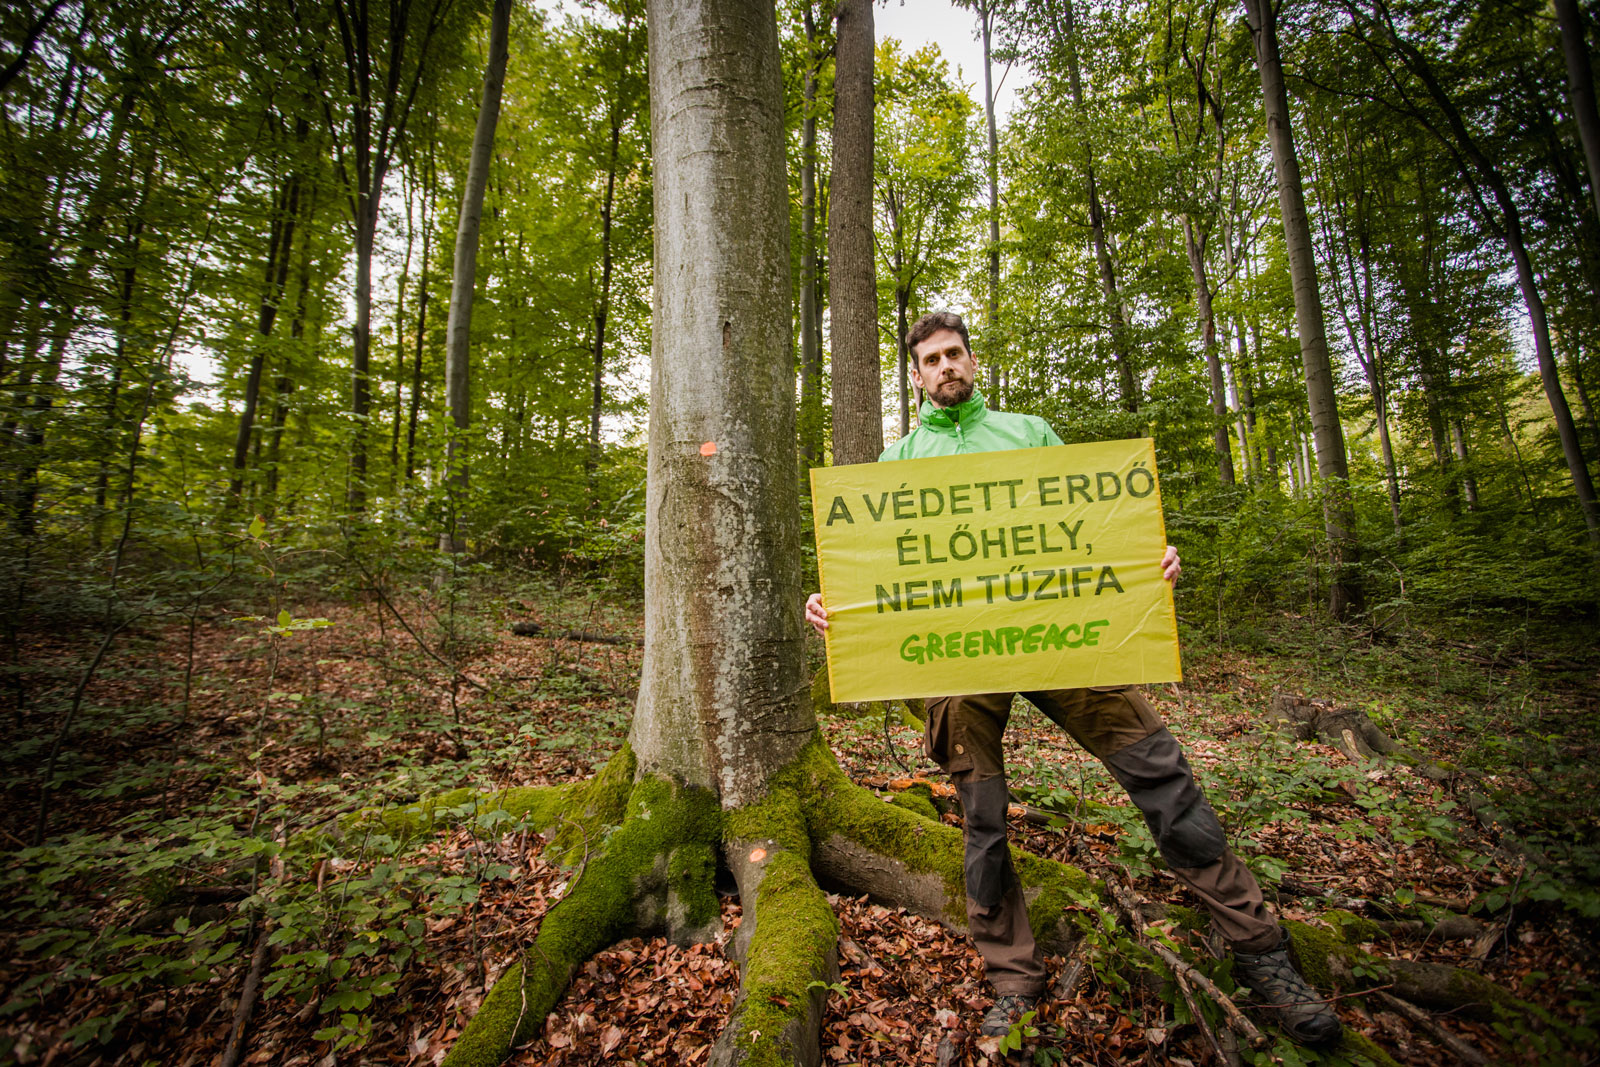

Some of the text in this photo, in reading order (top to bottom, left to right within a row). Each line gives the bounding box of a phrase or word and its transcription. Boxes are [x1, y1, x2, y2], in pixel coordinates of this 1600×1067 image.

[826, 460, 1156, 527] A VÉDETT ERDŐ
[896, 519, 1093, 566] ÉLŐHELY,
[875, 564, 1125, 614] NEM TŰZIFA
[899, 619, 1110, 665] GREENPEACE
